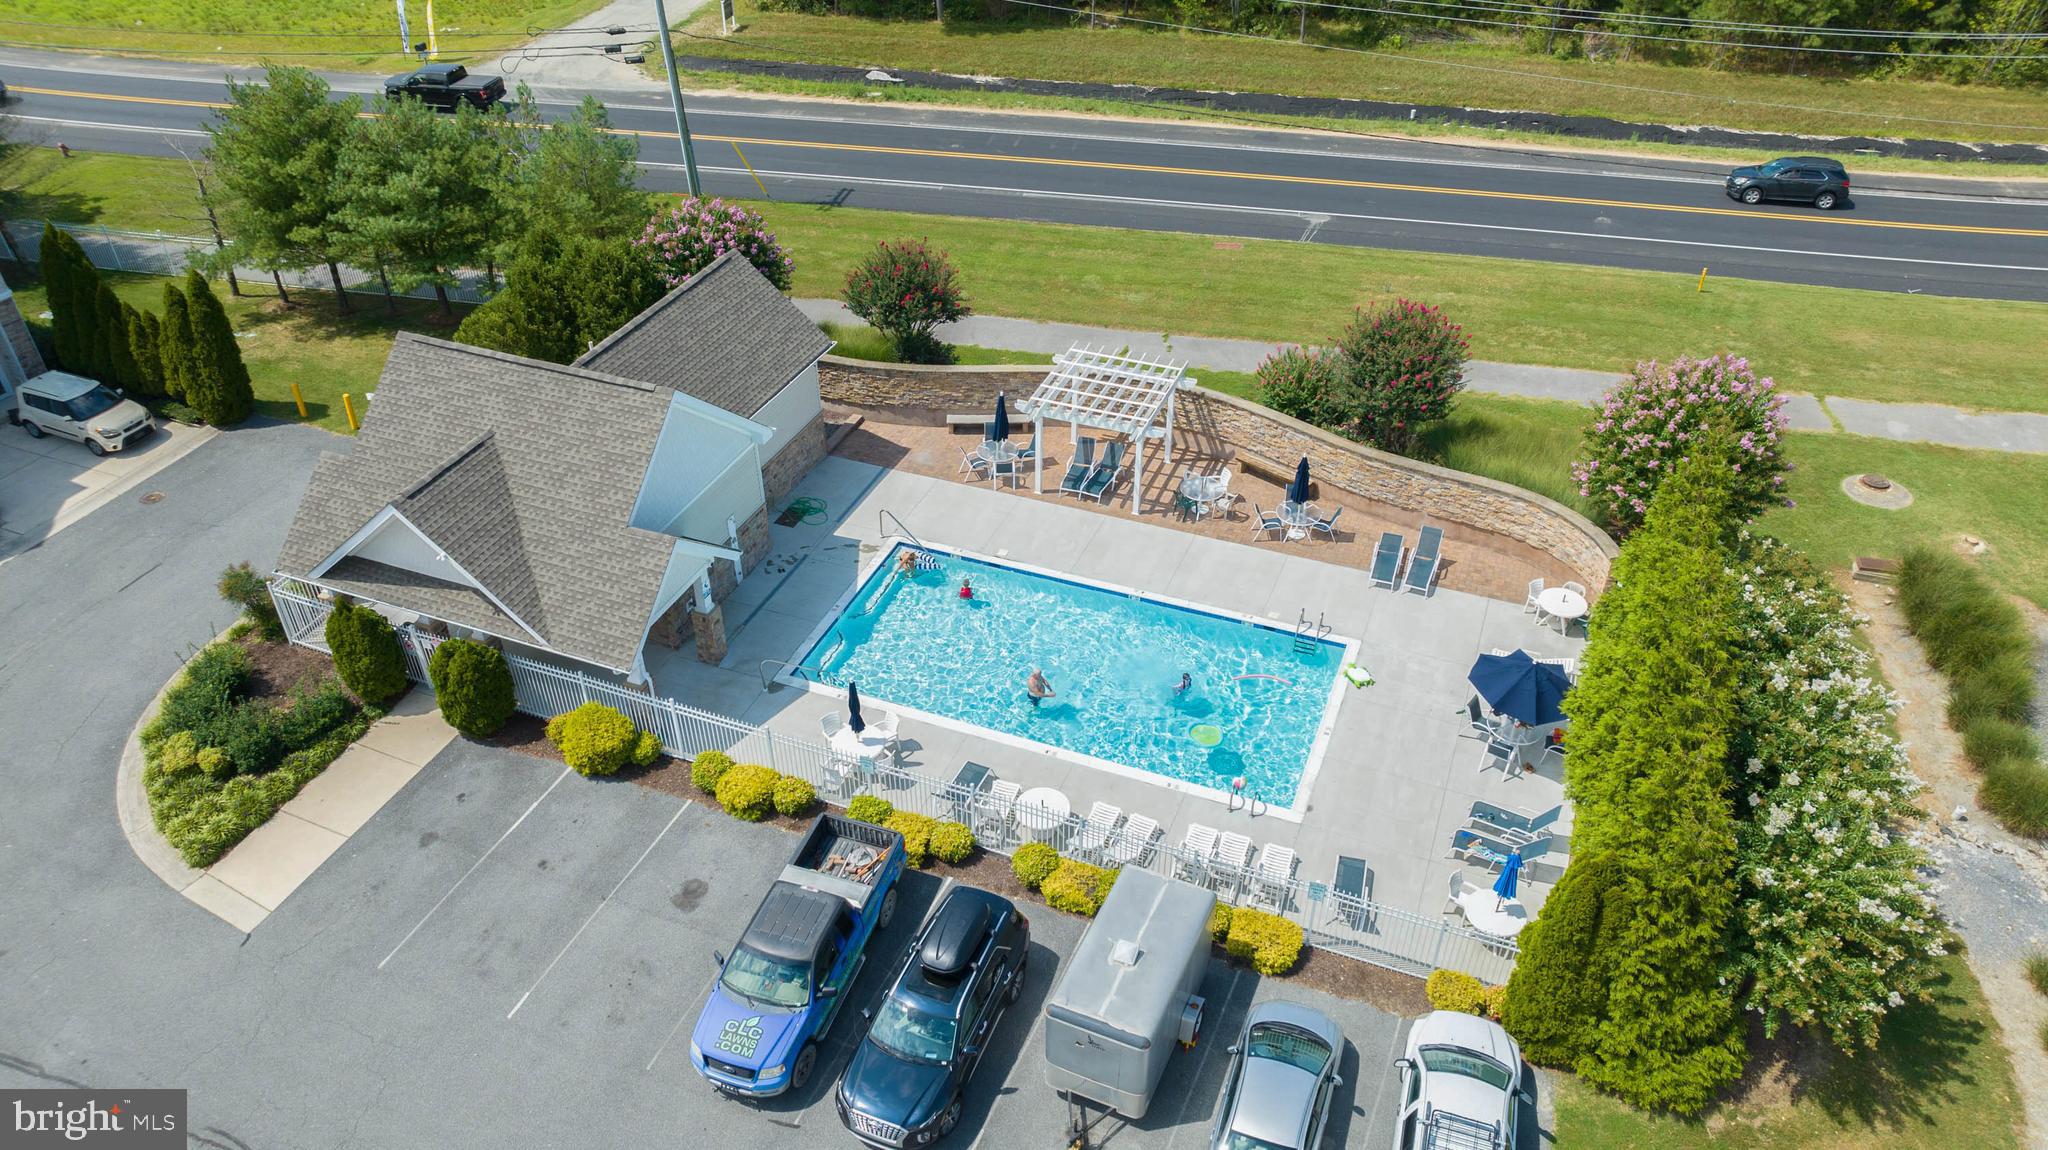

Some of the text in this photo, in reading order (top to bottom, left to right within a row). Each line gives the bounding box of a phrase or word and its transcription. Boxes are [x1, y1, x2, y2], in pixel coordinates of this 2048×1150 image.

[725, 1019, 763, 1039] CLC
[720, 1031, 758, 1048] LAWNS
[715, 1041, 753, 1057] .COM
